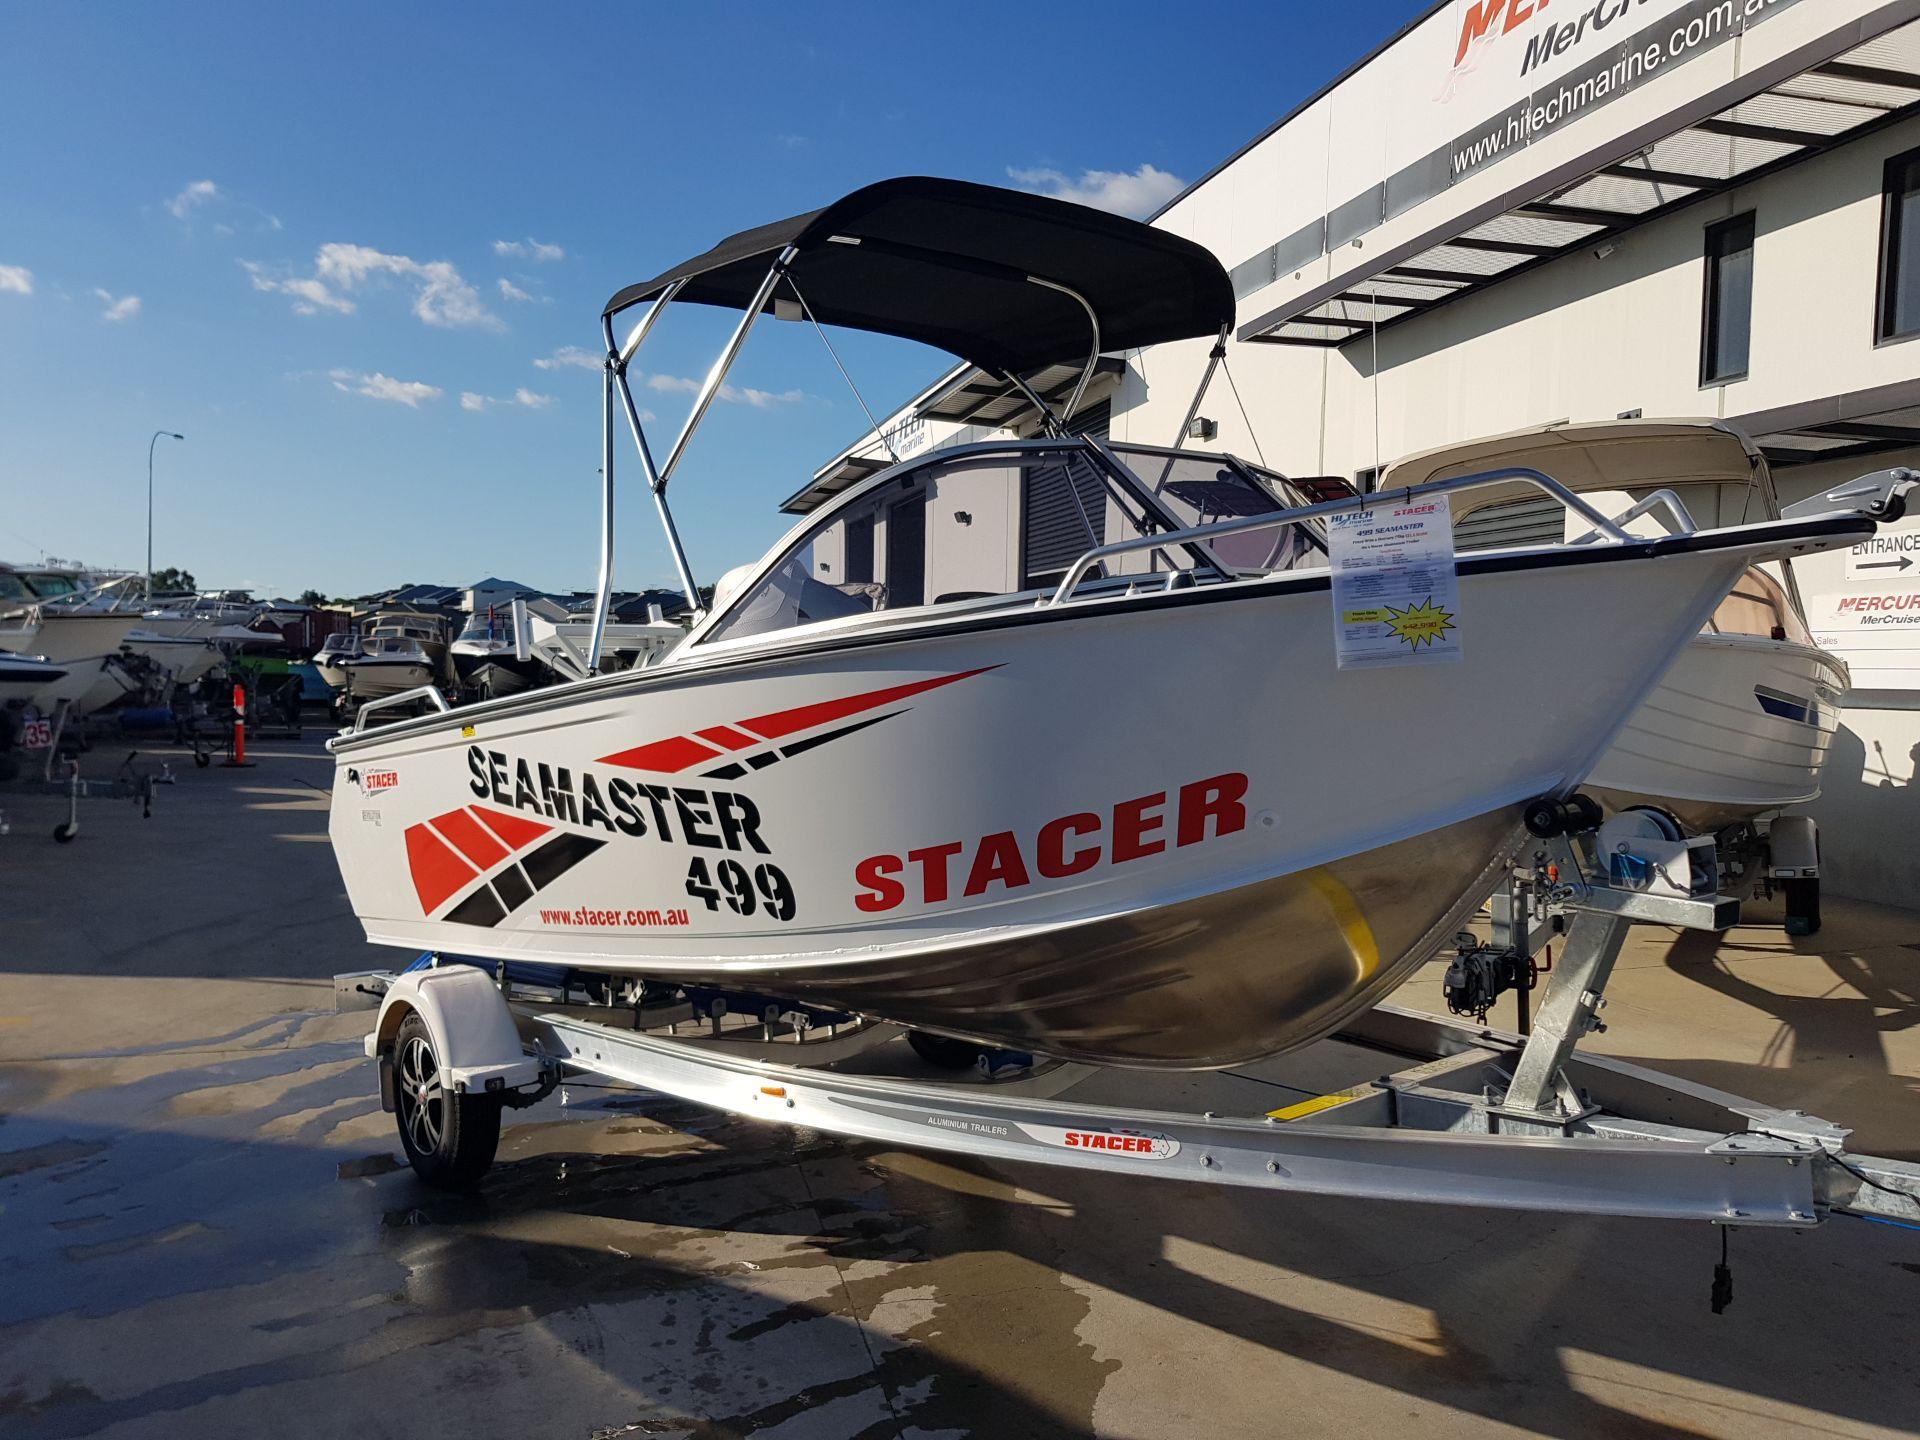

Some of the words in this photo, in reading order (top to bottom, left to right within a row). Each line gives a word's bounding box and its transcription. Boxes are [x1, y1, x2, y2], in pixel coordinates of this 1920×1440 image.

[901, 432, 925, 455] marine
[1346, 511, 1374, 521] TECH
[1393, 504, 1436, 517] STACER
[1357, 529, 1373, 537] 499
[1375, 522, 1424, 535] SEAMASTER
[1852, 534, 1920, 555] ENTRANCE
[1816, 636, 1839, 645] Sales
[366, 772, 399, 789] STACER
[467, 745, 772, 855] SEAMASTER
[854, 772, 1249, 913] STACER
[685, 856, 797, 922] 499
[540, 906, 690, 927] www.stacer.com.au
[927, 1116, 968, 1130] ALUMINIUM
[970, 1123, 1008, 1136] TRAILERS
[1064, 1132, 1152, 1153] STACER
